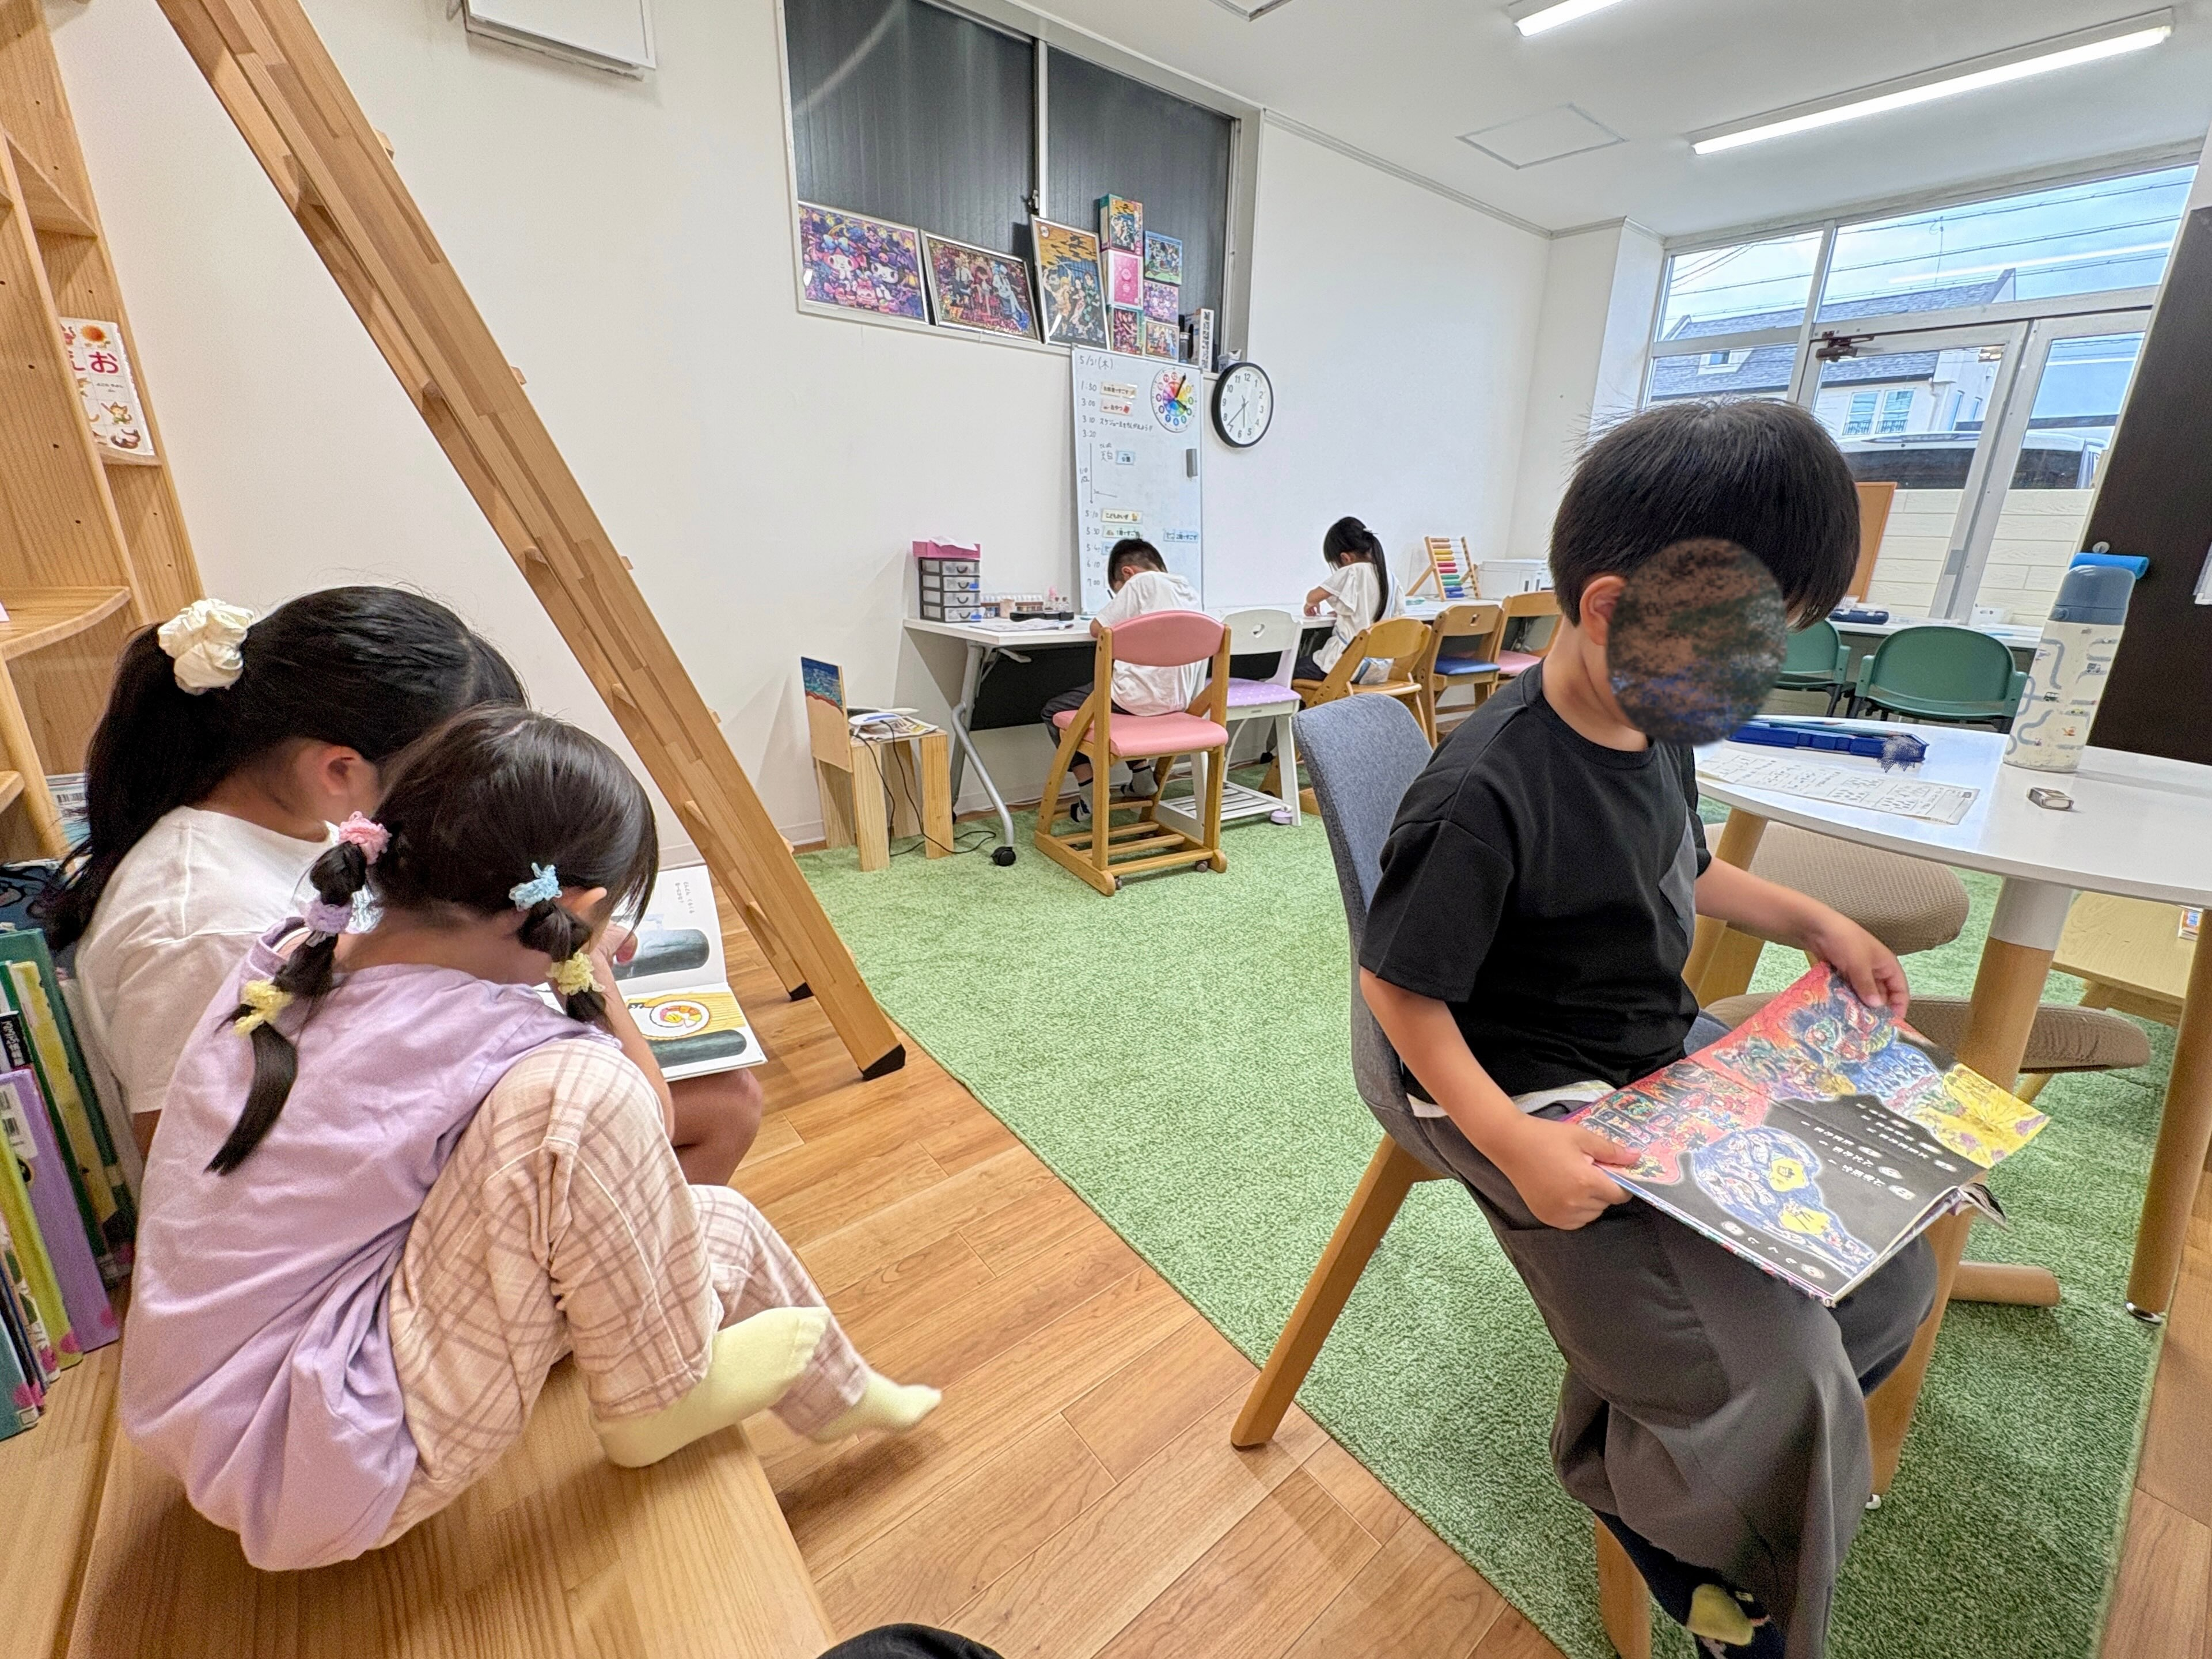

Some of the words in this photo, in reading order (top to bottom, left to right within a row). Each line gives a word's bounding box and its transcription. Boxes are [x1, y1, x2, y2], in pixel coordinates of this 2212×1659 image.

[1234, 374, 1241, 384] 11
[1243, 373, 1251, 382] 12
[1254, 379, 1258, 388] 1
[1226, 384, 1234, 393] 10
[1259, 391, 1264, 400] 2
[1221, 398, 1227, 407] 9
[1259, 405, 1264, 413] 3
[1223, 412, 1228, 422] 8
[1237, 429, 1242, 438] 6
[1247, 427, 1252, 436] 5
